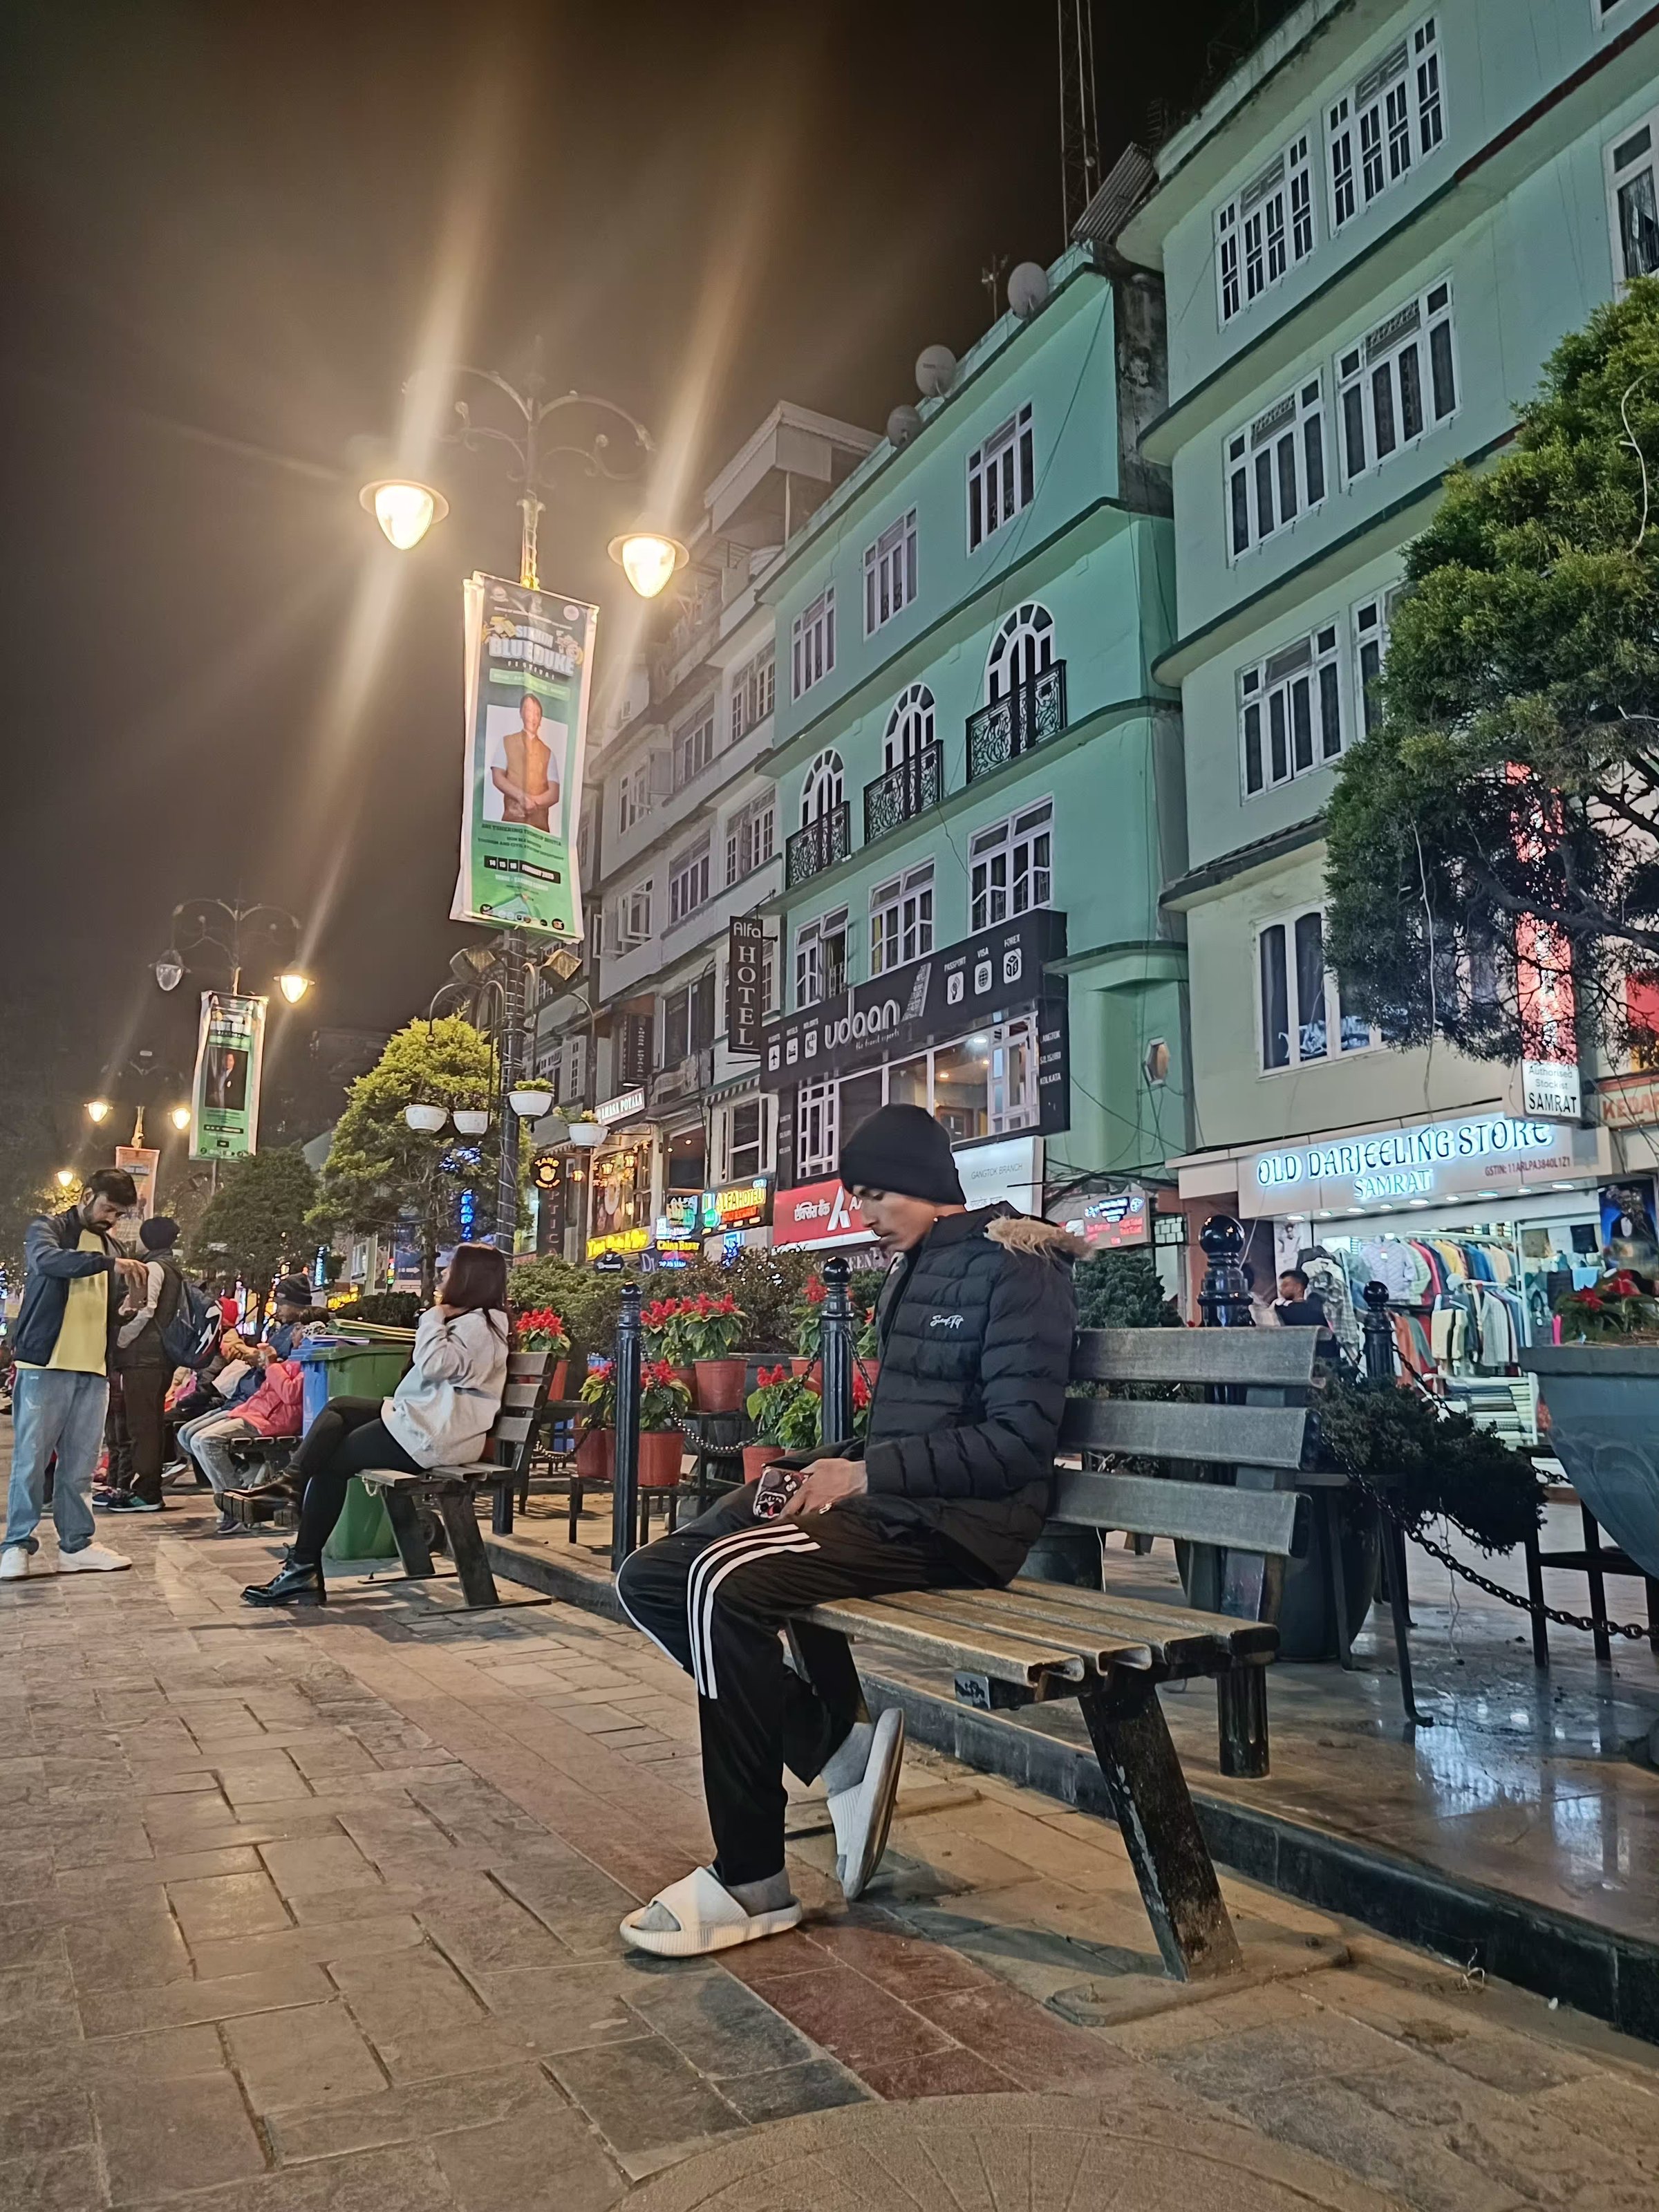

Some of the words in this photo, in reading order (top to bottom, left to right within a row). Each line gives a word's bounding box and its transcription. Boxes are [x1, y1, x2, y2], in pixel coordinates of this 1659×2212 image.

[489, 636, 533, 662] BLUE
[533, 644, 575, 677] DUKE
[733, 921, 761, 939] Alfa
[944, 956, 966, 972] PASSPORT
[977, 947, 989, 959] VISA
[1004, 933, 1020, 948] FOREX
[738, 945, 756, 1046] HOTEL
[825, 987, 901, 1049] udaan
[1529, 1065, 1573, 1078] Authorised
[1535, 1079, 1568, 1090] Stockist
[1528, 1092, 1577, 1114] SAMRAT
[1257, 1154, 1300, 1185] OLD
[1308, 1126, 1454, 1179] DARJEELING
[1459, 1119, 1550, 1156] STORE
[971, 1168, 998, 1180] GANGTOK
[999, 1163, 1023, 1175] BRANCH
[1354, 1169, 1432, 1199] SAMRAT
[716, 1192, 738, 1212] ALFA
[738, 1188, 763, 1207] HOTEL
[657, 1239, 678, 1251] China
[679, 1240, 700, 1251] Bazar
